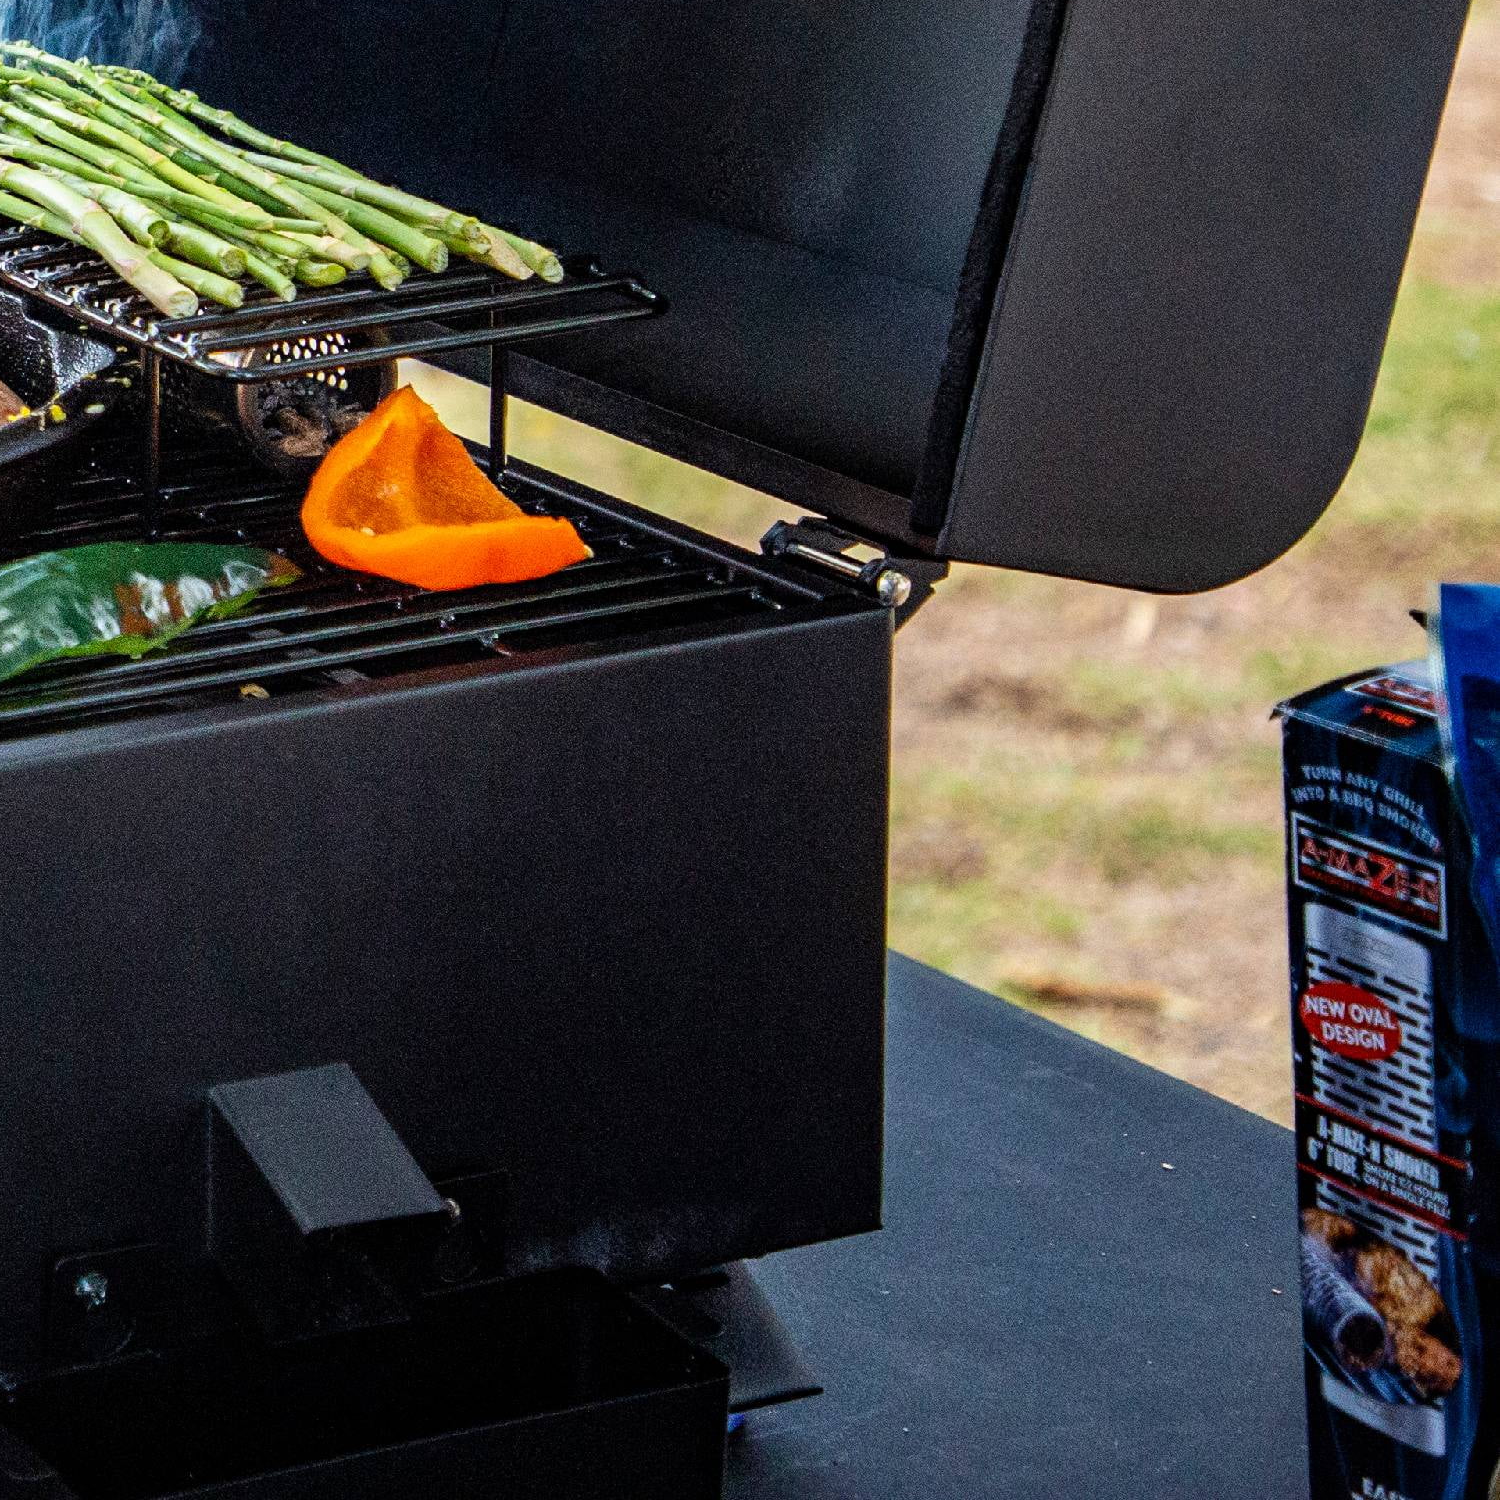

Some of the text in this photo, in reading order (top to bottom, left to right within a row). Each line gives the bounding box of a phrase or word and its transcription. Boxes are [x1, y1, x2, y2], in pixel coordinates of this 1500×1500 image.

[1291, 786, 1325, 803] INTO
[1329, 786, 1340, 802] A
[1343, 790, 1374, 816] BBQ
[1301, 765, 1424, 821] TURN ANY GRILL
[1304, 994, 1397, 1030] NEW OVAL
[1321, 1021, 1386, 1051] DESIGN
